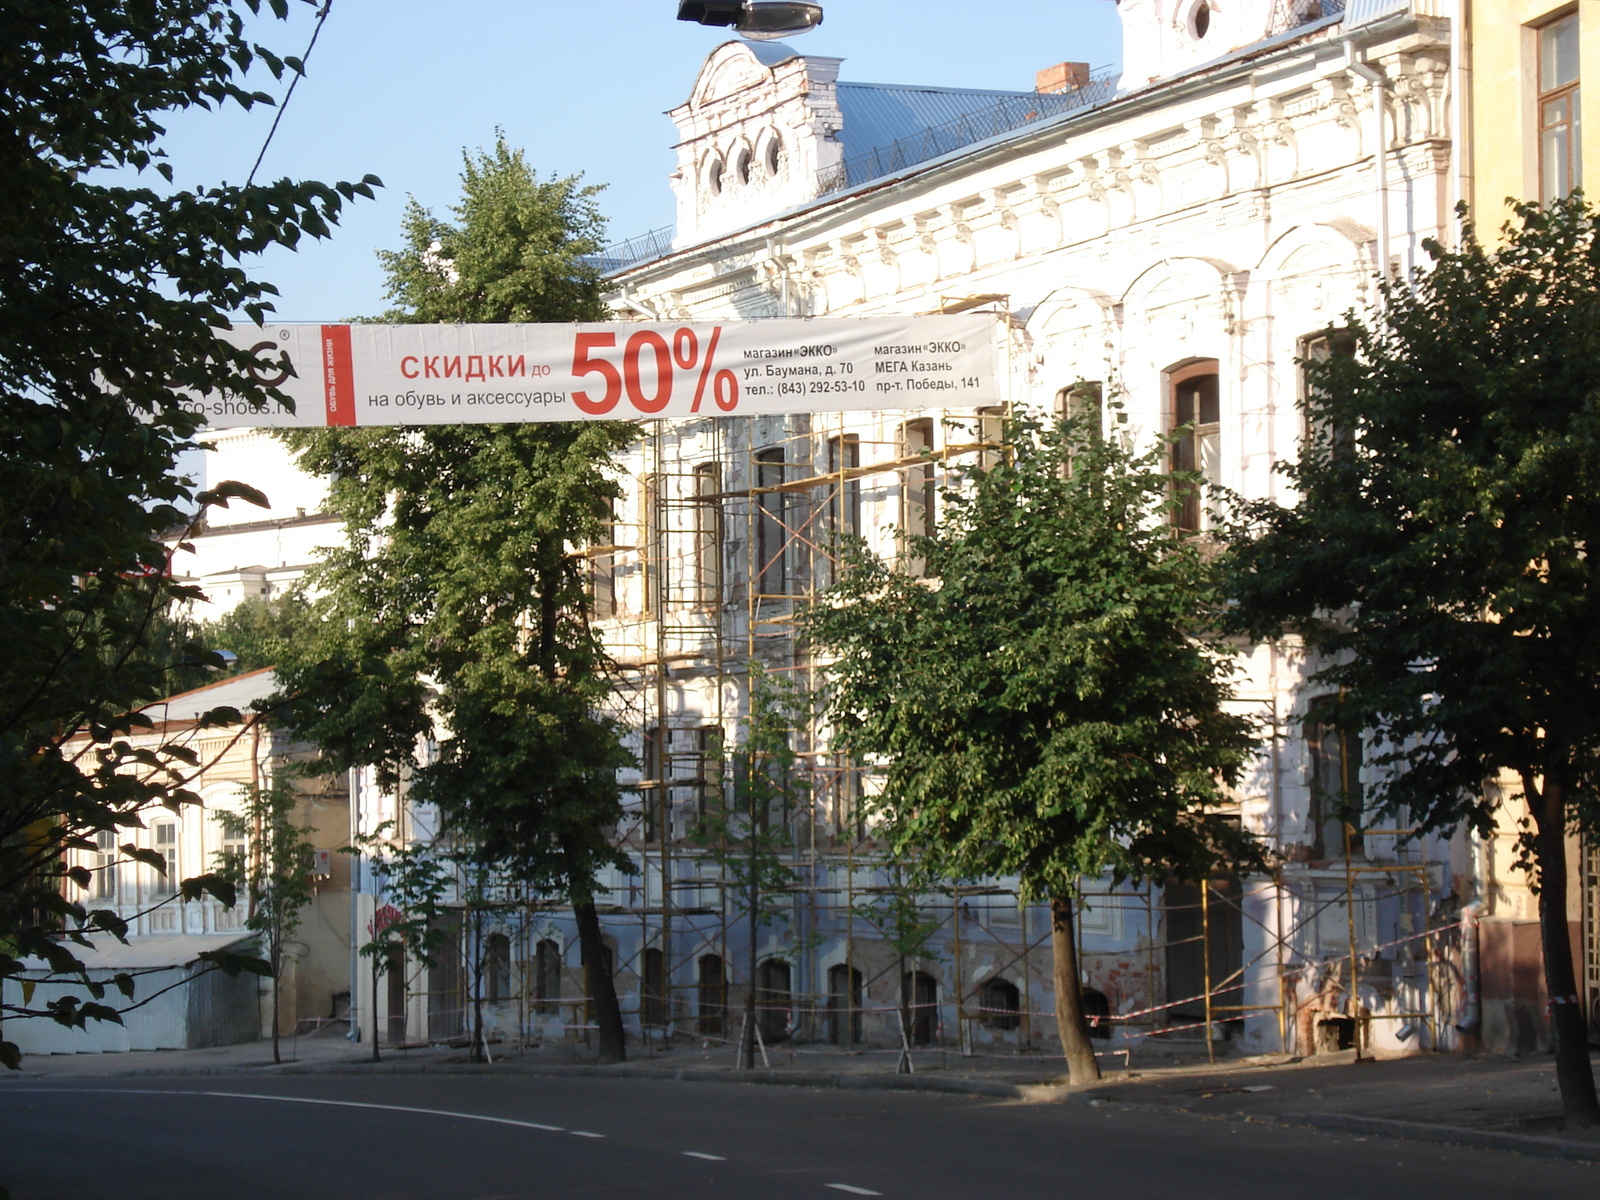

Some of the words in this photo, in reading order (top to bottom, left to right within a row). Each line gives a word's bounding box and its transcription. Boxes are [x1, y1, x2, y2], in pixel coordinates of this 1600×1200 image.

[400, 355, 526, 382] СКИДКИ
[531, 364, 551, 378] до
[570, 326, 739, 415] 50%
[743, 368, 762, 380] ул.
[765, 365, 822, 379] Баумана,
[824, 365, 837, 377] д.
[839, 362, 854, 374] 70
[875, 361, 908, 373] МЕГА
[911, 360, 953, 372] Казань
[745, 385, 774, 396] тел.:
[777, 381, 807, 398] (843)
[809, 380, 866, 394] 292-53-10
[876, 381, 904, 394] пр-т.
[906, 378, 958, 391] Победы,
[960, 376, 980, 388] 141
[368, 395, 389, 407] на
[394, 390, 446, 410] обувь
[451, 393, 461, 406] и
[466, 391, 566, 408] аксессуары
